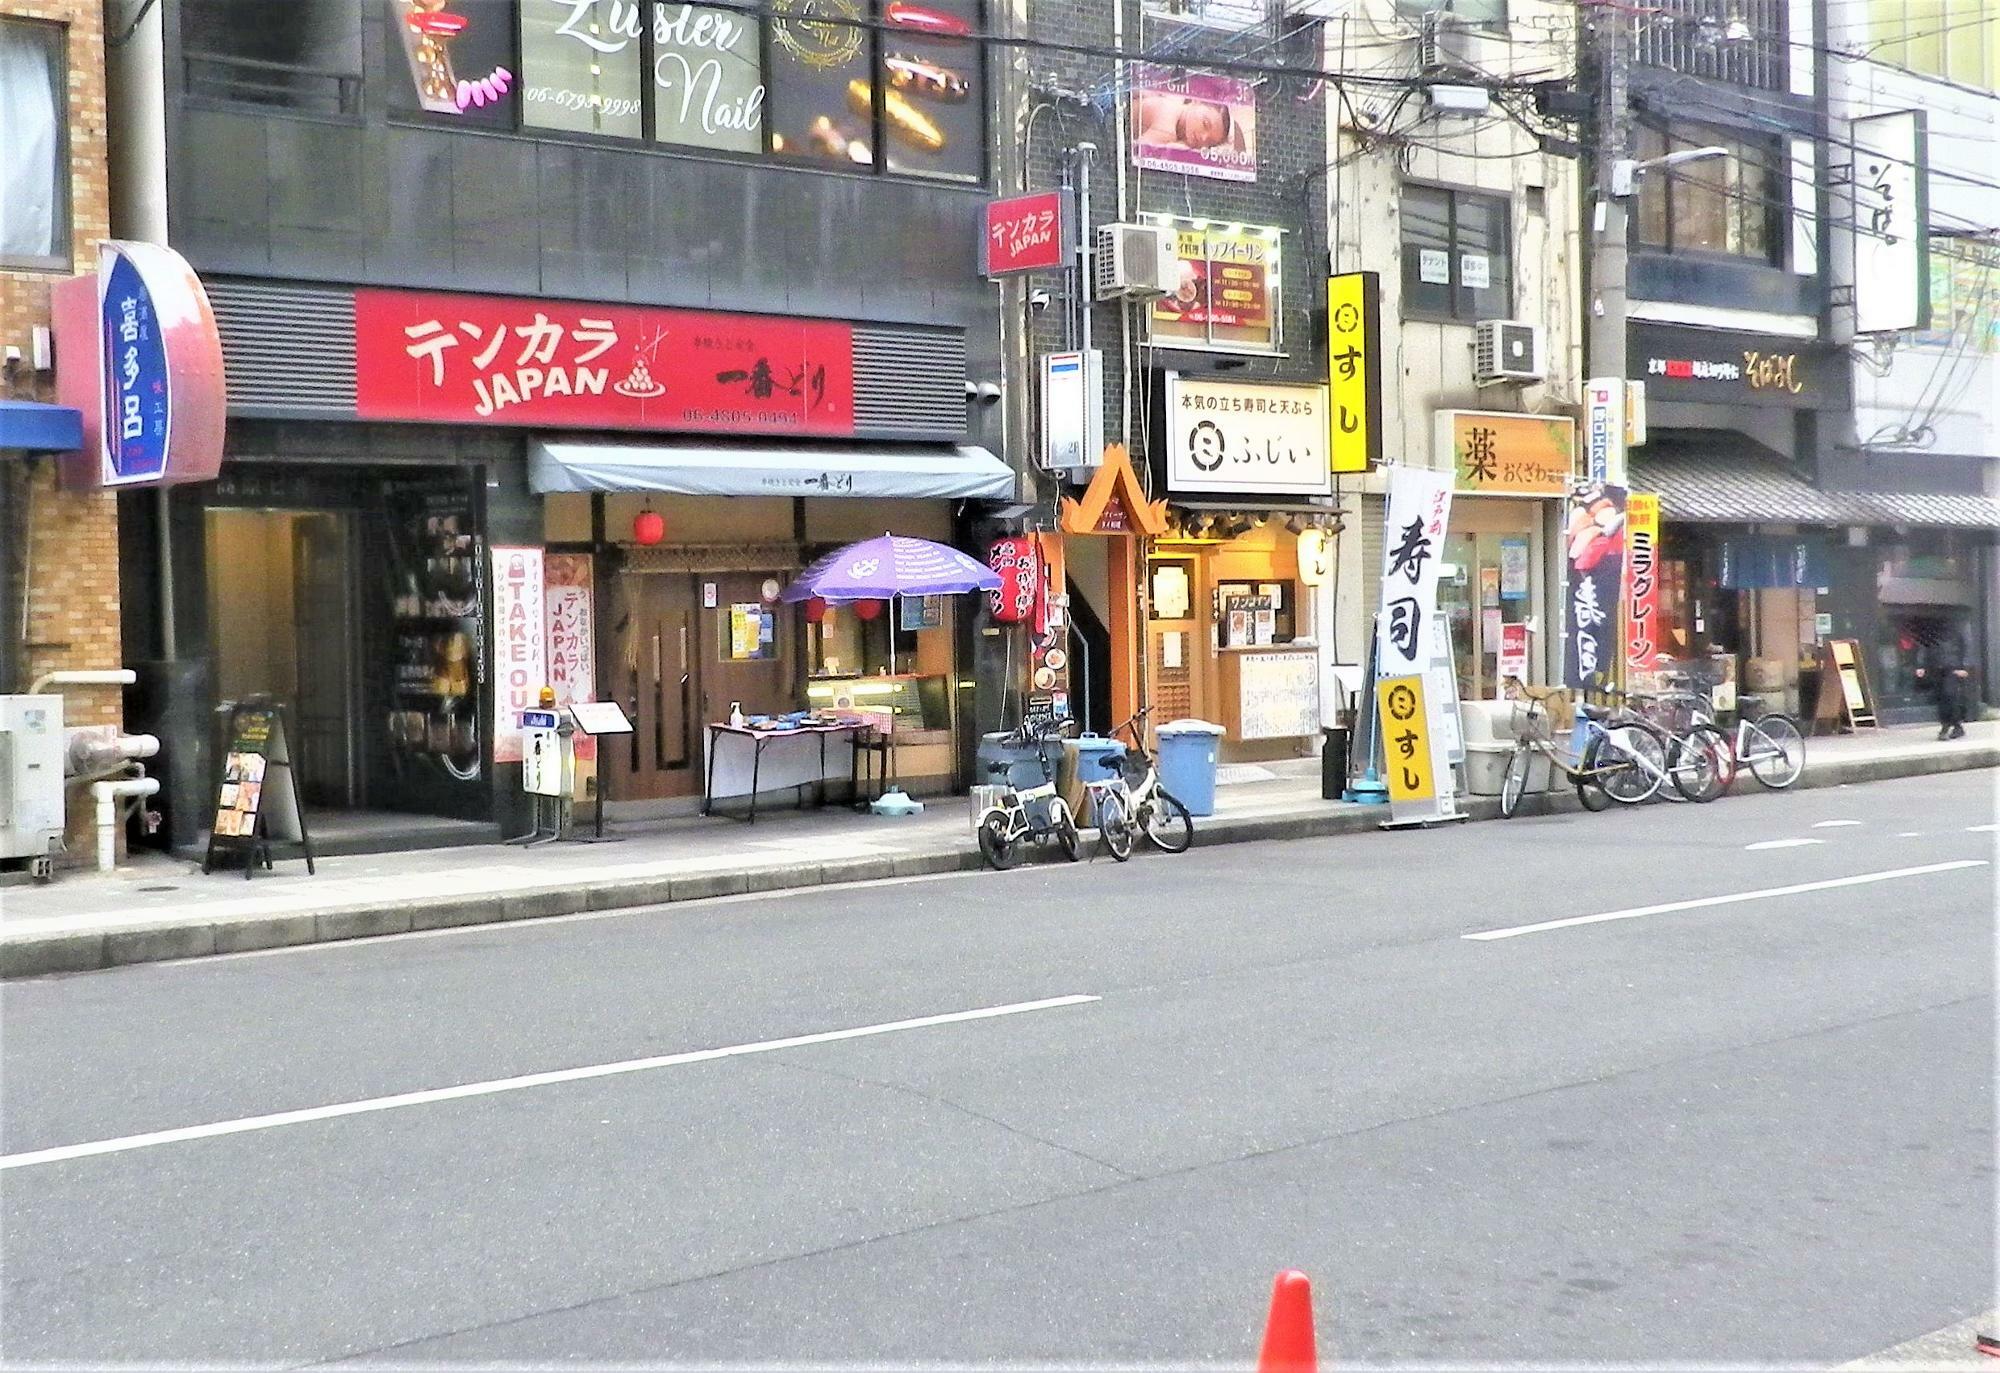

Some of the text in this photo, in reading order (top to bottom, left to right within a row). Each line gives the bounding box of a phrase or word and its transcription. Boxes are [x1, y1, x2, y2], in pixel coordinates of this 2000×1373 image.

[654, 53, 765, 134] Nail
[992, 212, 1054, 247] テンカラ
[1010, 231, 1051, 257] JAPAN
[403, 312, 619, 387] テンカラ
[474, 365, 609, 417] JAPAN
[1181, 393, 1313, 416] 本気の立ち寿司と天ぷら
[1333, 345, 1362, 434] すし
[1232, 436, 1311, 466] ふじい
[1464, 427, 1498, 482] 薬
[1387, 514, 1432, 662] 寿司
[508, 581, 527, 663] TAKE
[552, 603, 567, 682] JAPAN
[1395, 728, 1420, 790] すし
